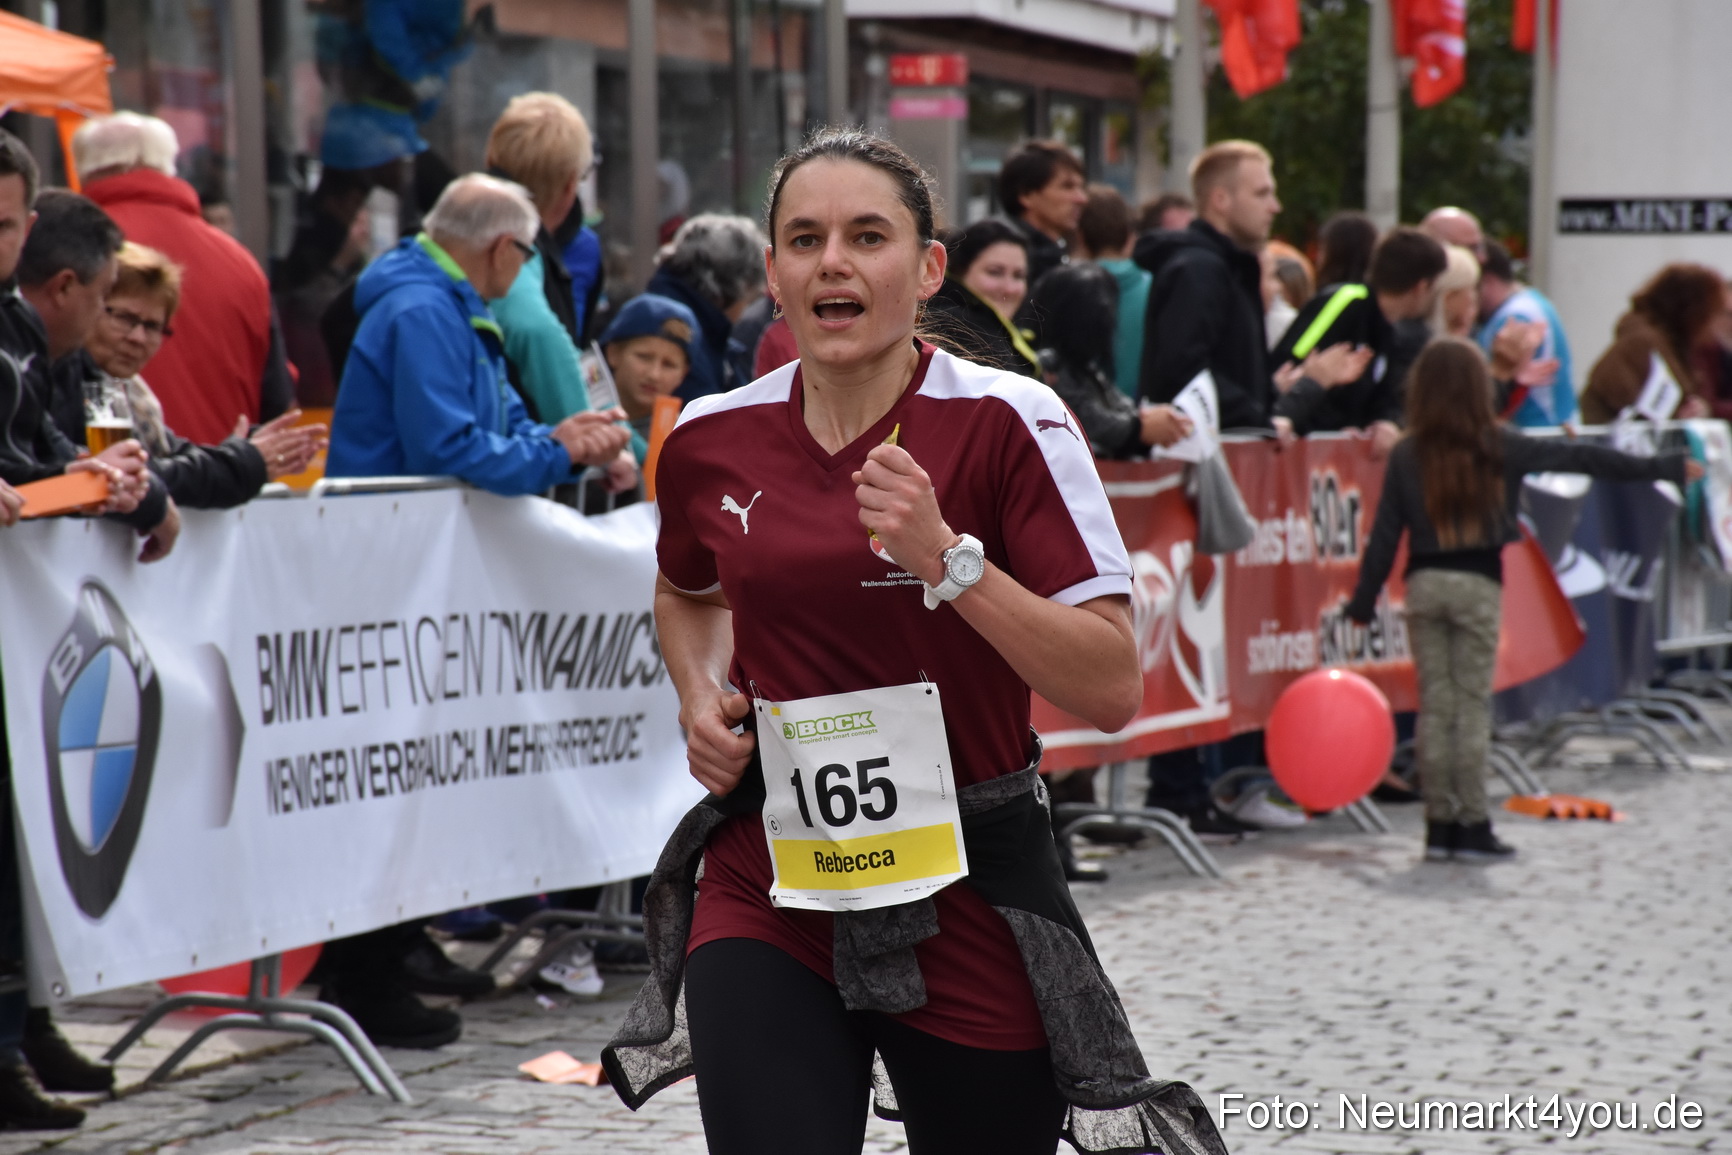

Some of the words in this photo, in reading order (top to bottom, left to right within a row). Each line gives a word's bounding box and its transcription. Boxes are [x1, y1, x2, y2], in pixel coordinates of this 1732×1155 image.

[860, 579, 926, 587] Wallenstein-Halbma
[257, 627, 333, 726] BMW
[796, 710, 876, 738] BOCK
[798, 737, 822, 745] inspired
[851, 728, 878, 737] concepts
[790, 756, 898, 828] 165
[814, 849, 896, 873] Rebecca
